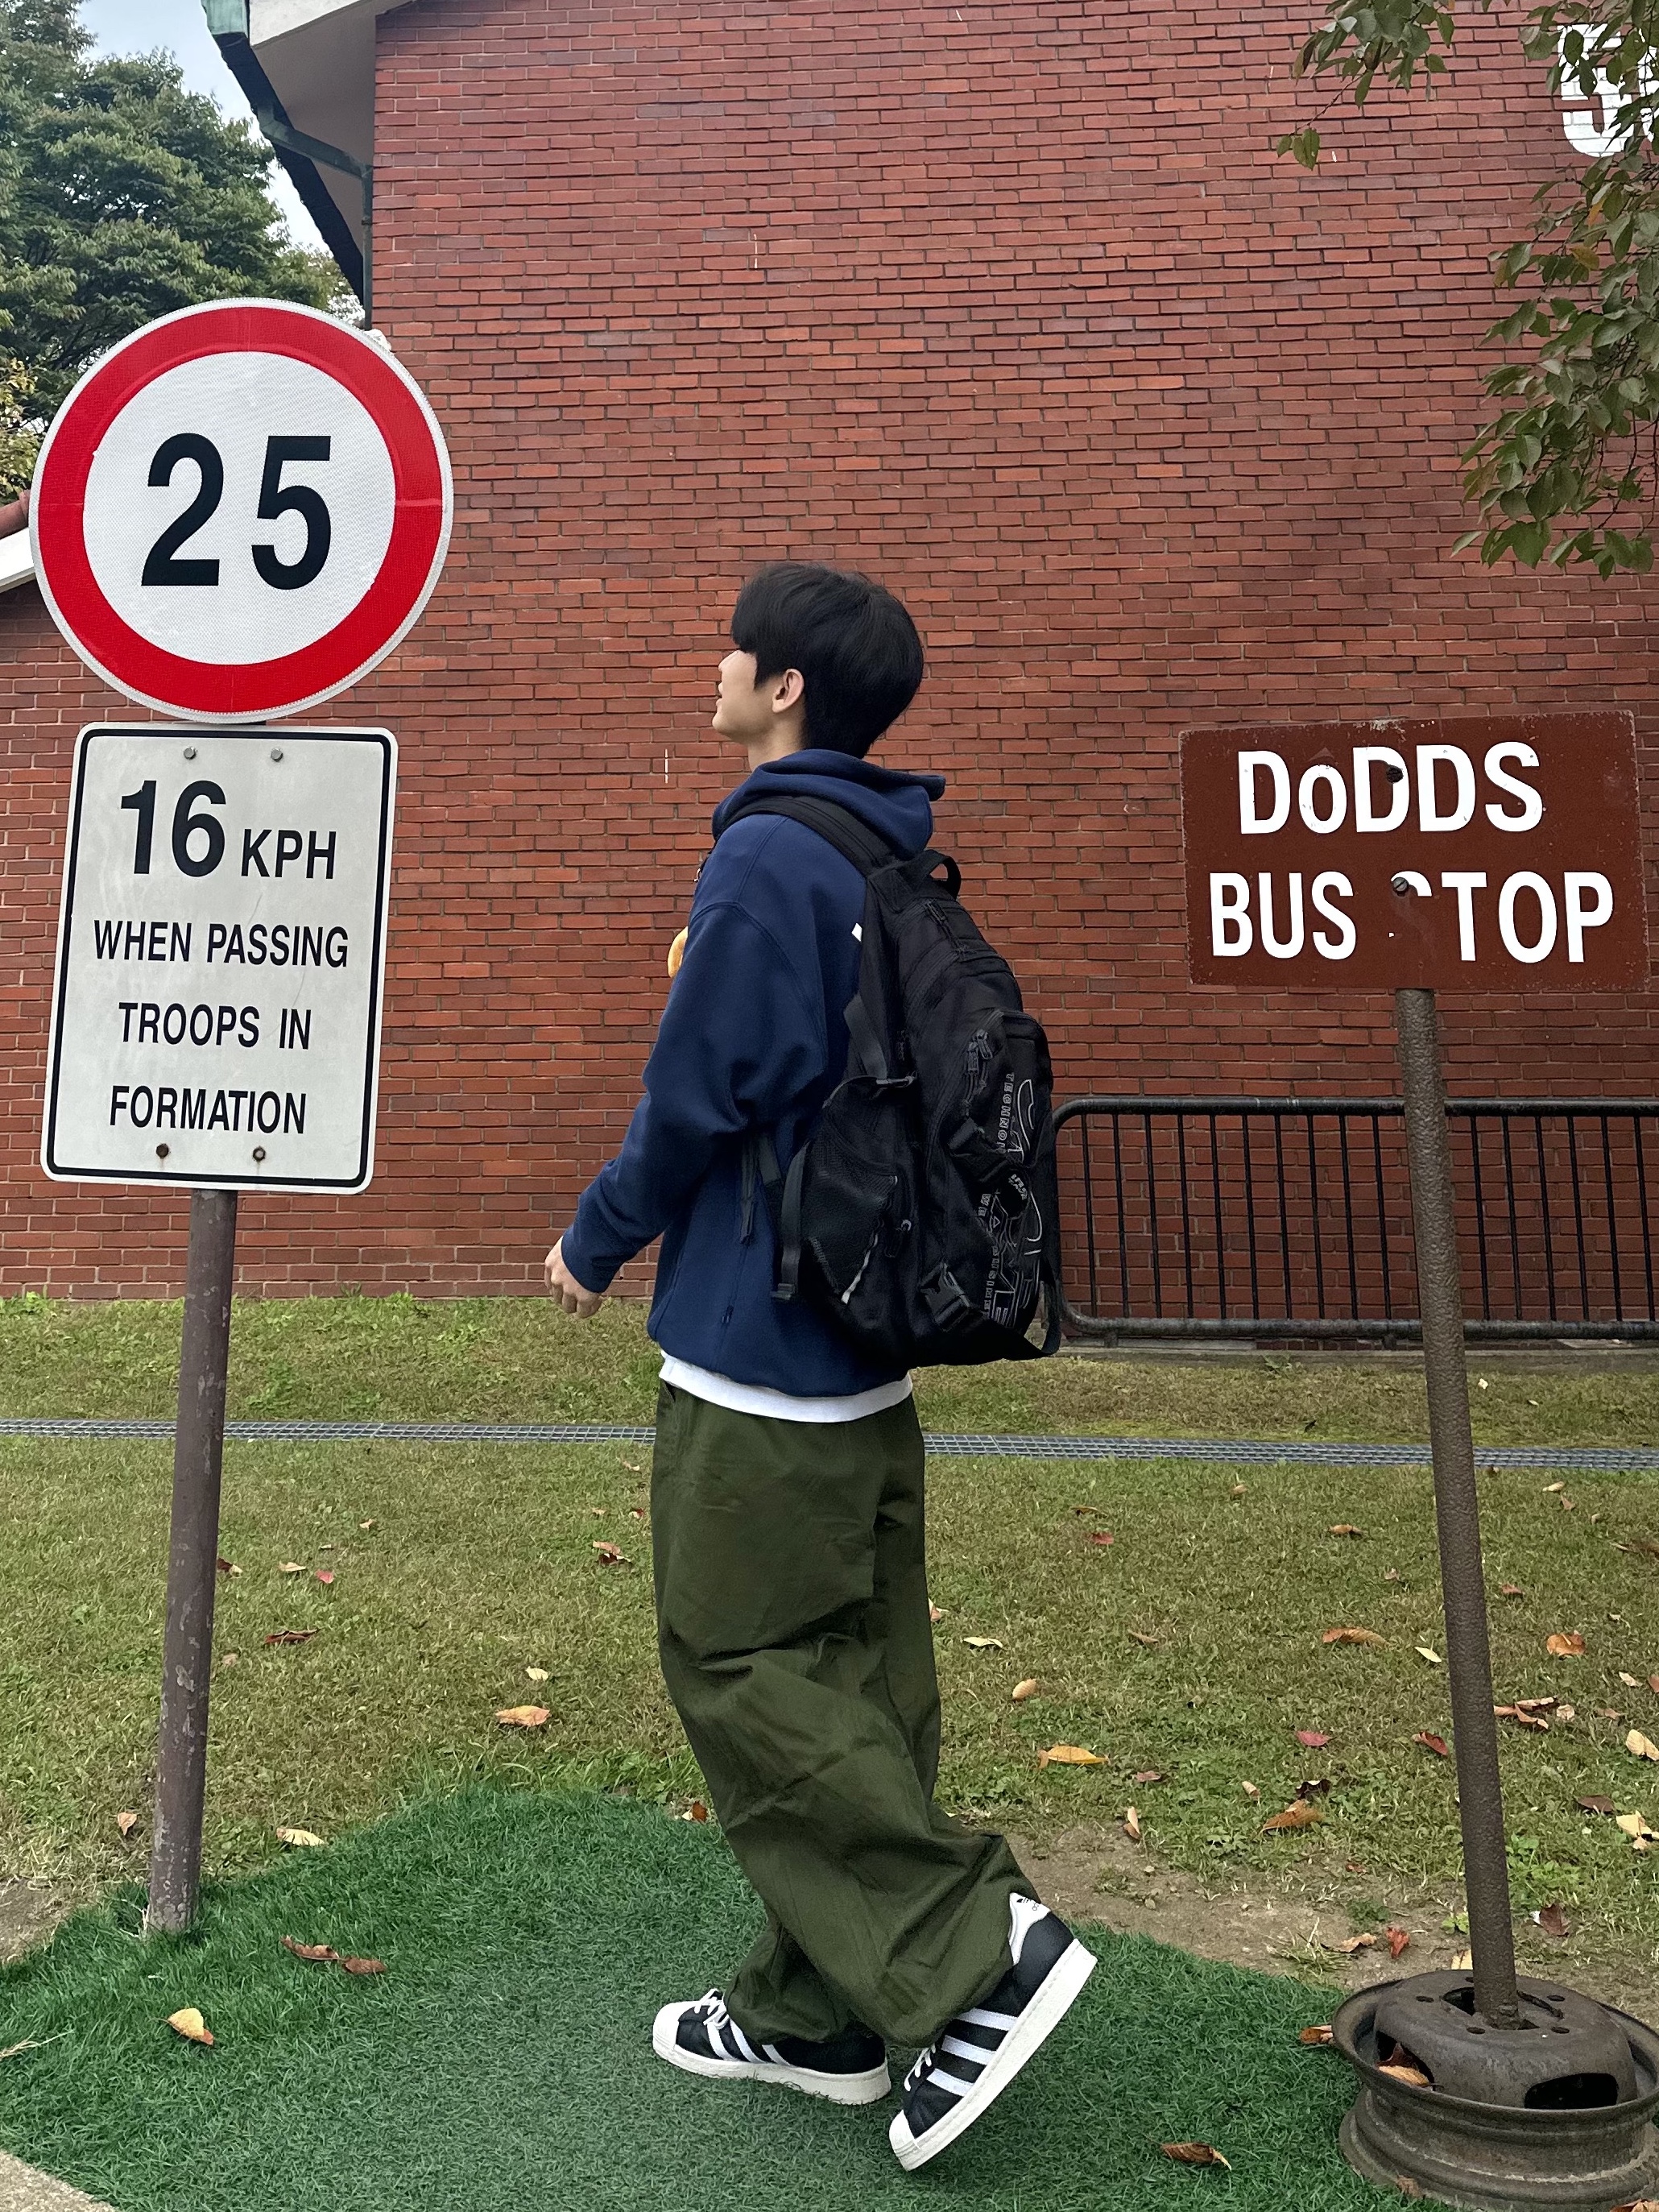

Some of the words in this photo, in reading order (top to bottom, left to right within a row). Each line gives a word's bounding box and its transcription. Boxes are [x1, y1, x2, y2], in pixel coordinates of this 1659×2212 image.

[141, 433, 331, 590] 25
[120, 780, 226, 877] 16
[241, 828, 337, 880] KPH
[1238, 741, 1544, 835] DoDDS
[93, 919, 192, 963] WHEN
[206, 923, 349, 968] PASSING
[1210, 871, 1356, 960] BUS
[1391, 871, 1613, 963] TOP
[118, 1001, 260, 1048] TROOPS
[279, 1008, 312, 1050] IN
[110, 1085, 307, 1134] FORMATION
